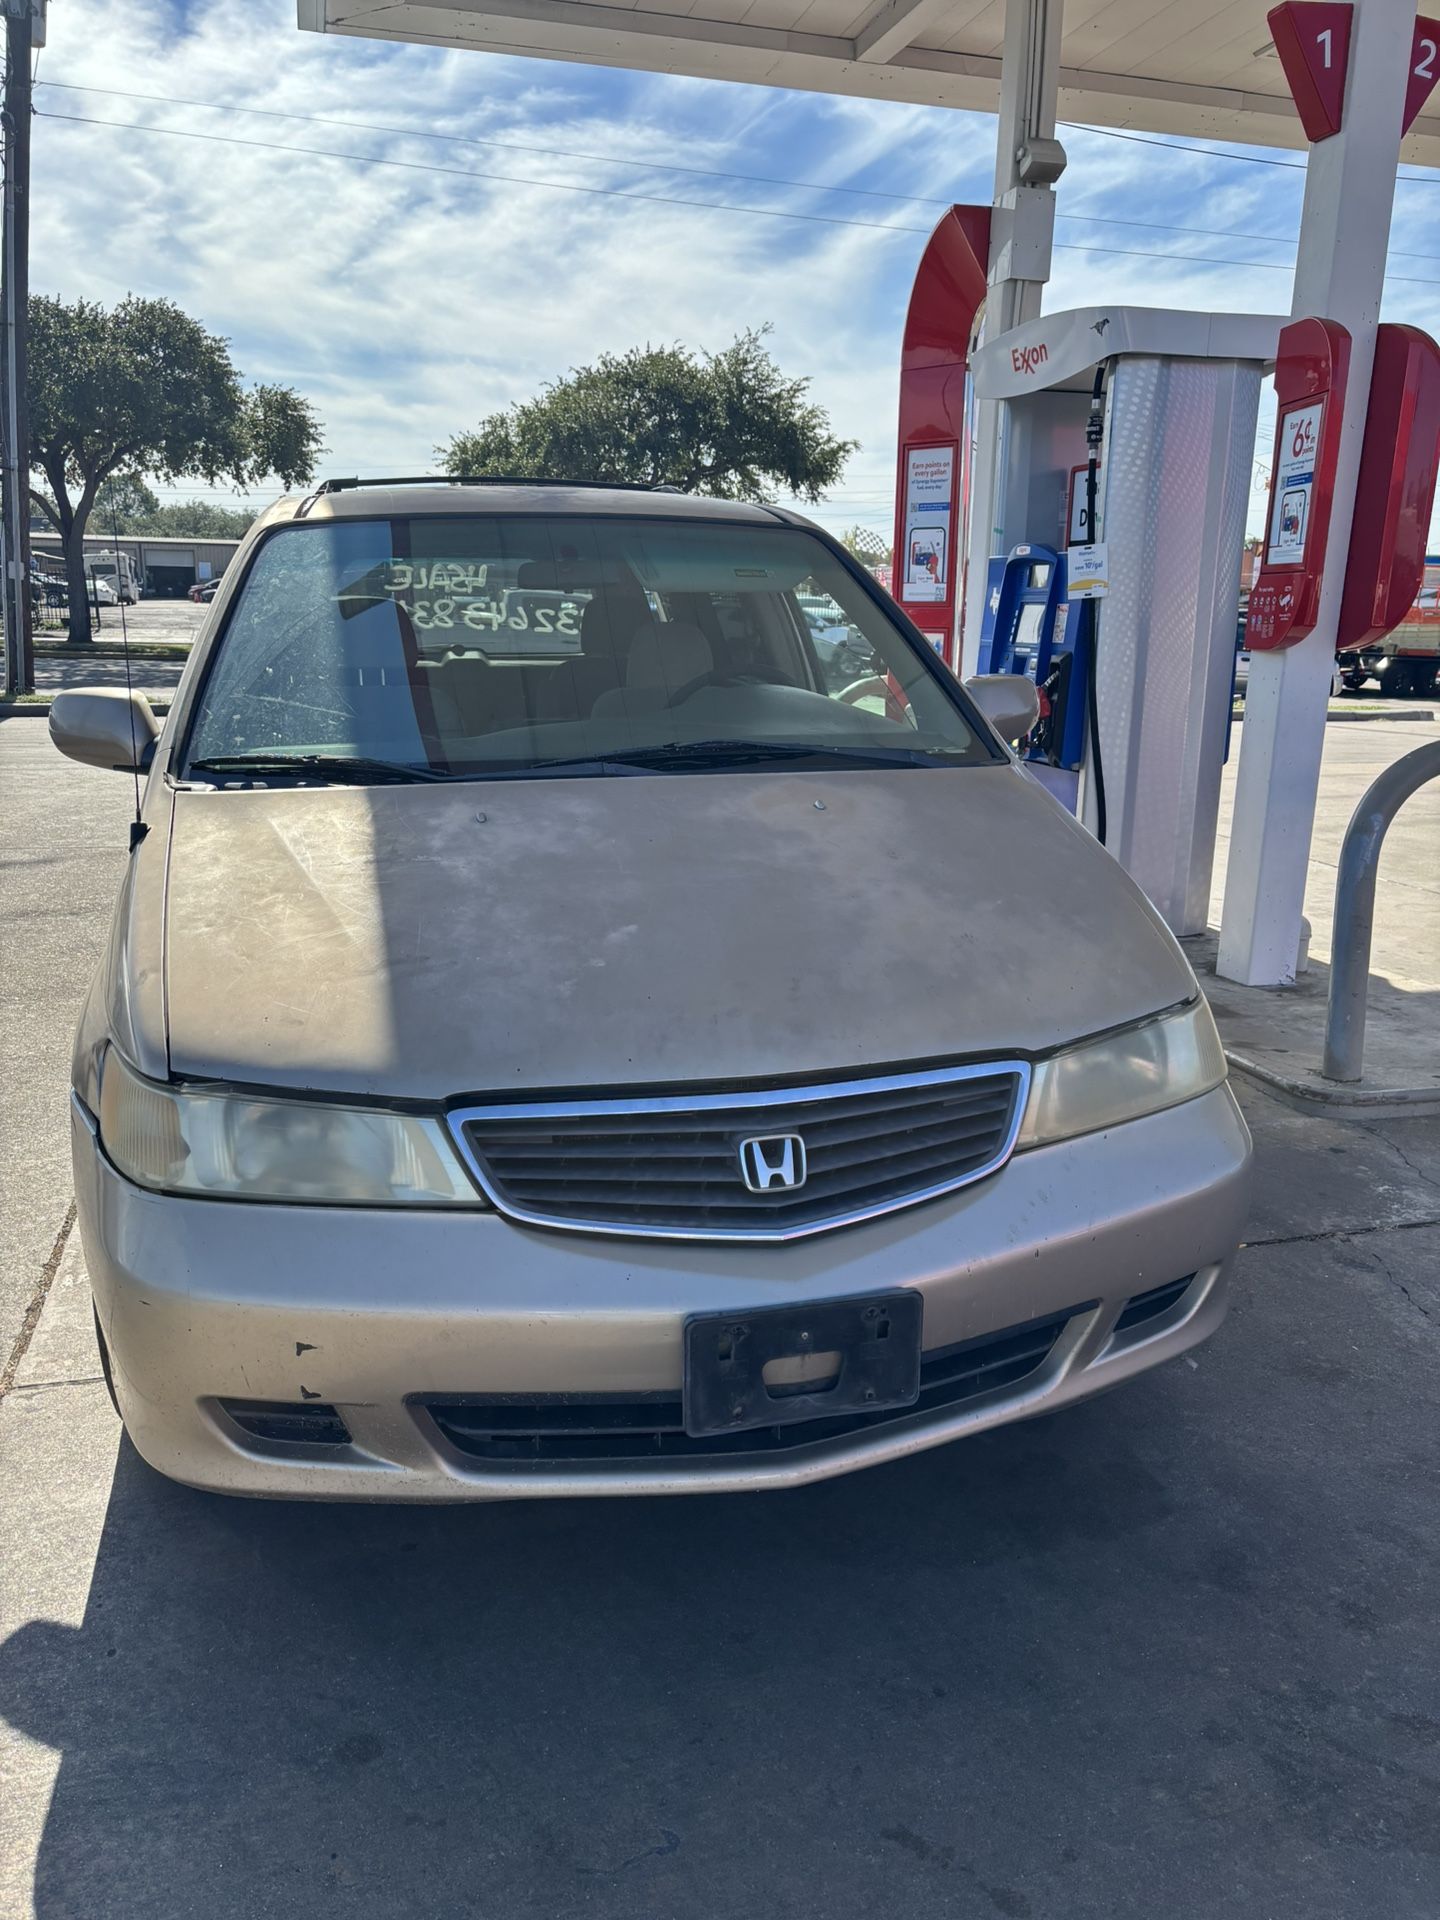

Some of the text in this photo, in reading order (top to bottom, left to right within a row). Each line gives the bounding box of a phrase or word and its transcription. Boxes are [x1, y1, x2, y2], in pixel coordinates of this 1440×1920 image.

[1317, 29, 1331, 68] 1
[1414, 39, 1437, 79] 2
[1011, 344, 1048, 374] Exxon
[925, 460, 942, 469] points
[930, 469, 947, 477] gallon
